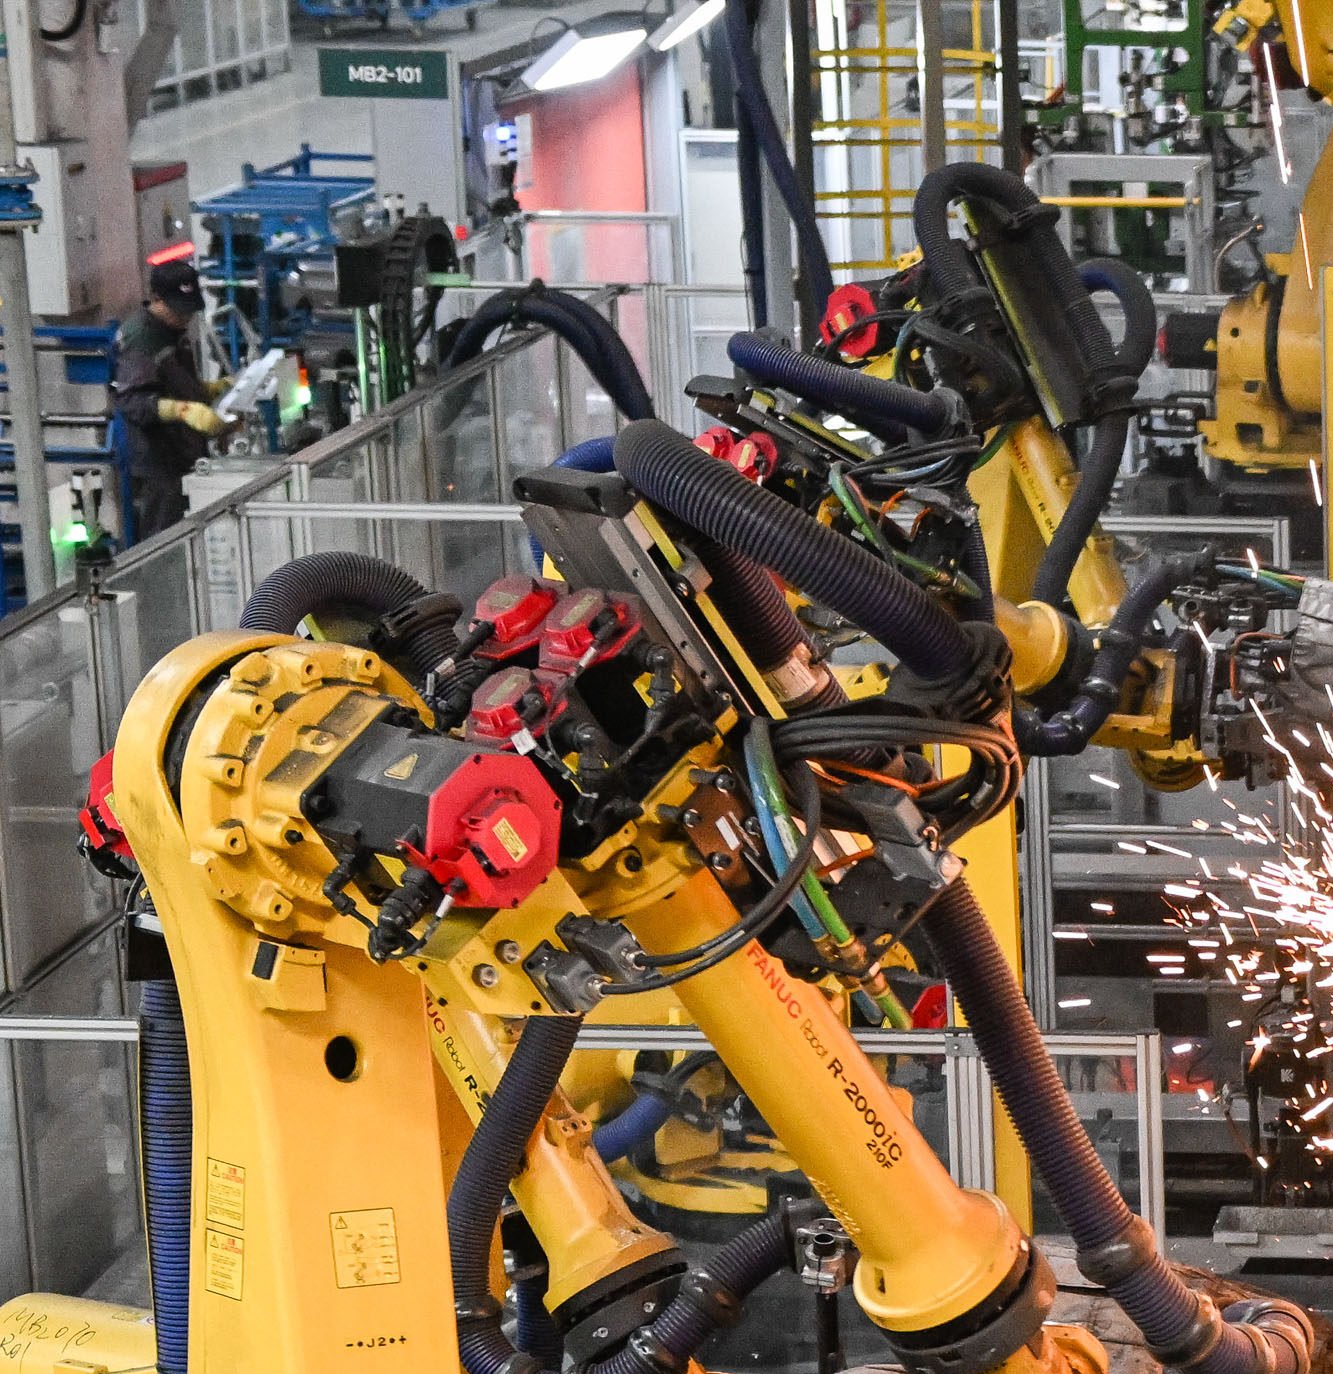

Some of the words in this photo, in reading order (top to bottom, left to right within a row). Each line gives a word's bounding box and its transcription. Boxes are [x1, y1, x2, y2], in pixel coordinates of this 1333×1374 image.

[348, 65, 422, 83] MB2-101
[443, 1036, 466, 1072] Robot
[747, 943, 802, 1019] FANUC
[827, 1057, 902, 1162] R-2000iC
[866, 1139, 893, 1170] 210F
